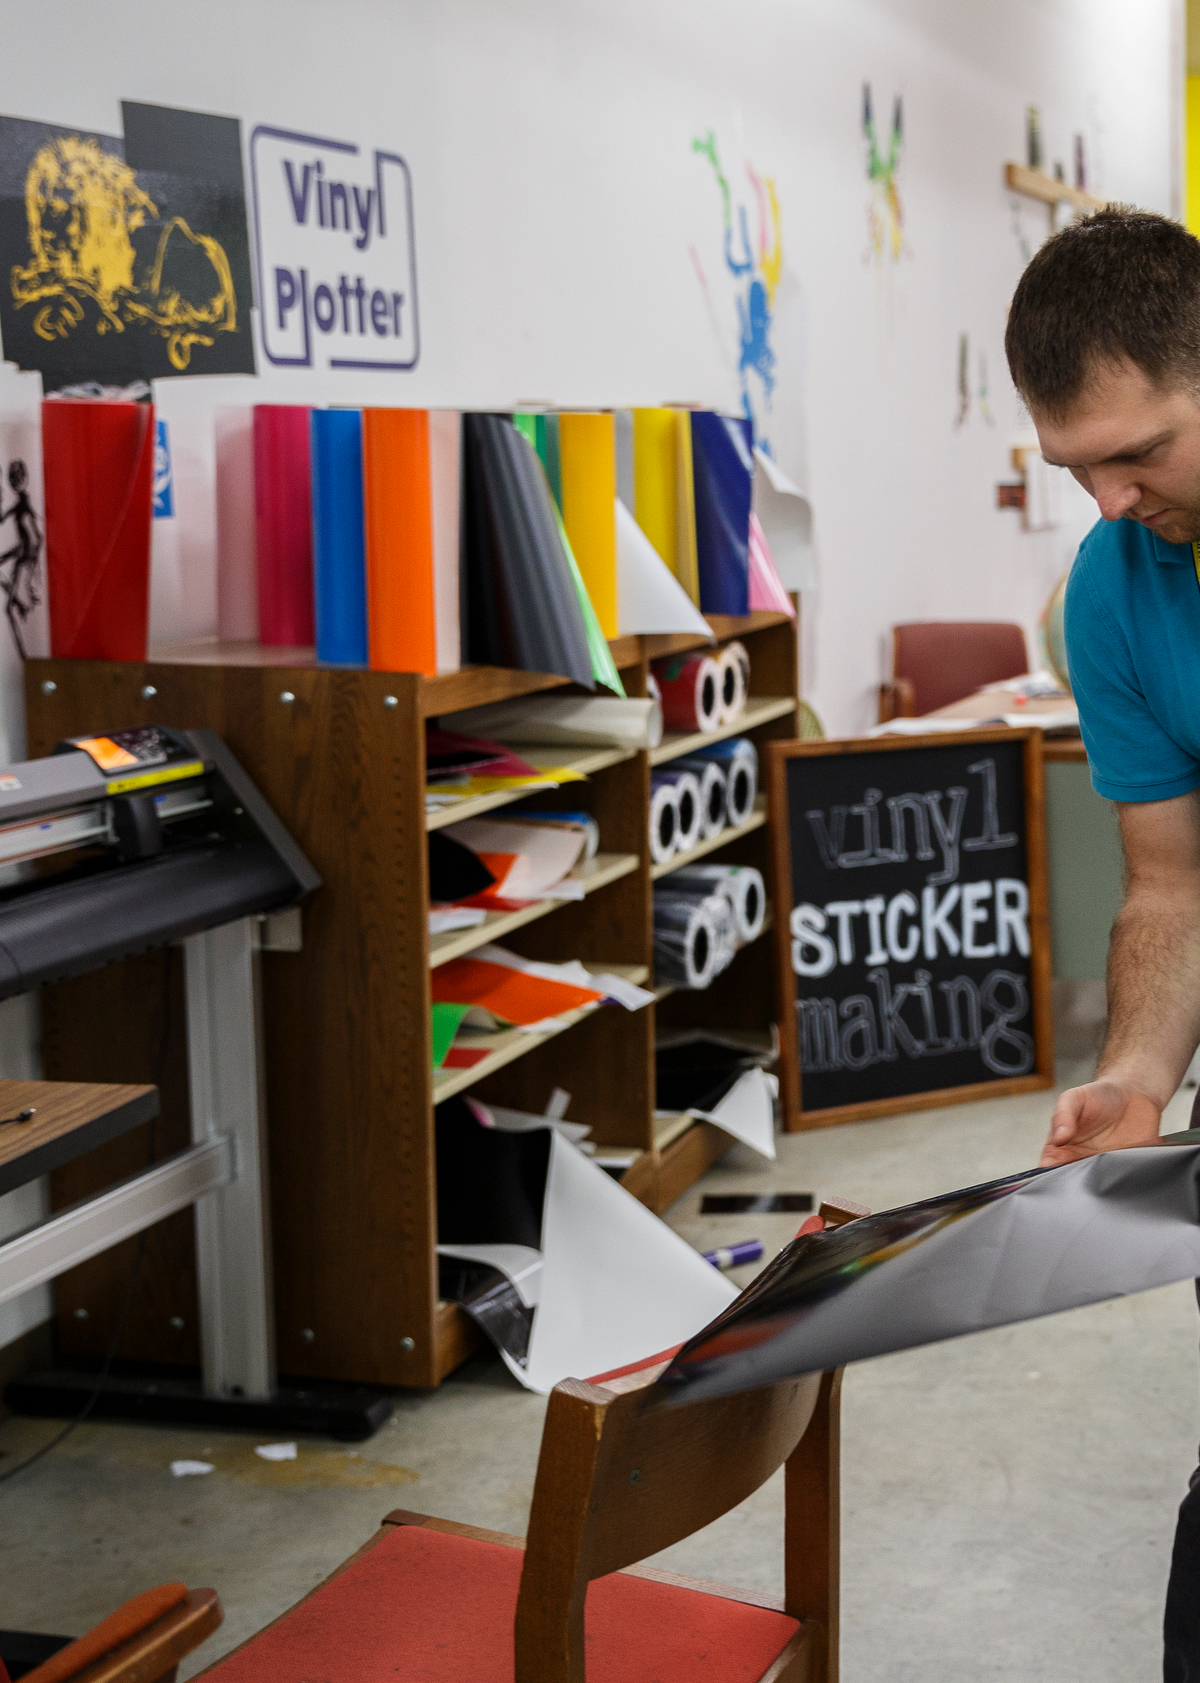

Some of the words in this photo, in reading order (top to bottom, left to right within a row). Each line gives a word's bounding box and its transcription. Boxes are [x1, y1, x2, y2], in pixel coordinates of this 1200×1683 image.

[282, 152, 388, 251] Vinyl
[275, 266, 405, 346] Plotter
[806, 757, 1018, 886] vinyl
[790, 877, 1031, 978] STICKER
[796, 967, 1036, 1076] making
